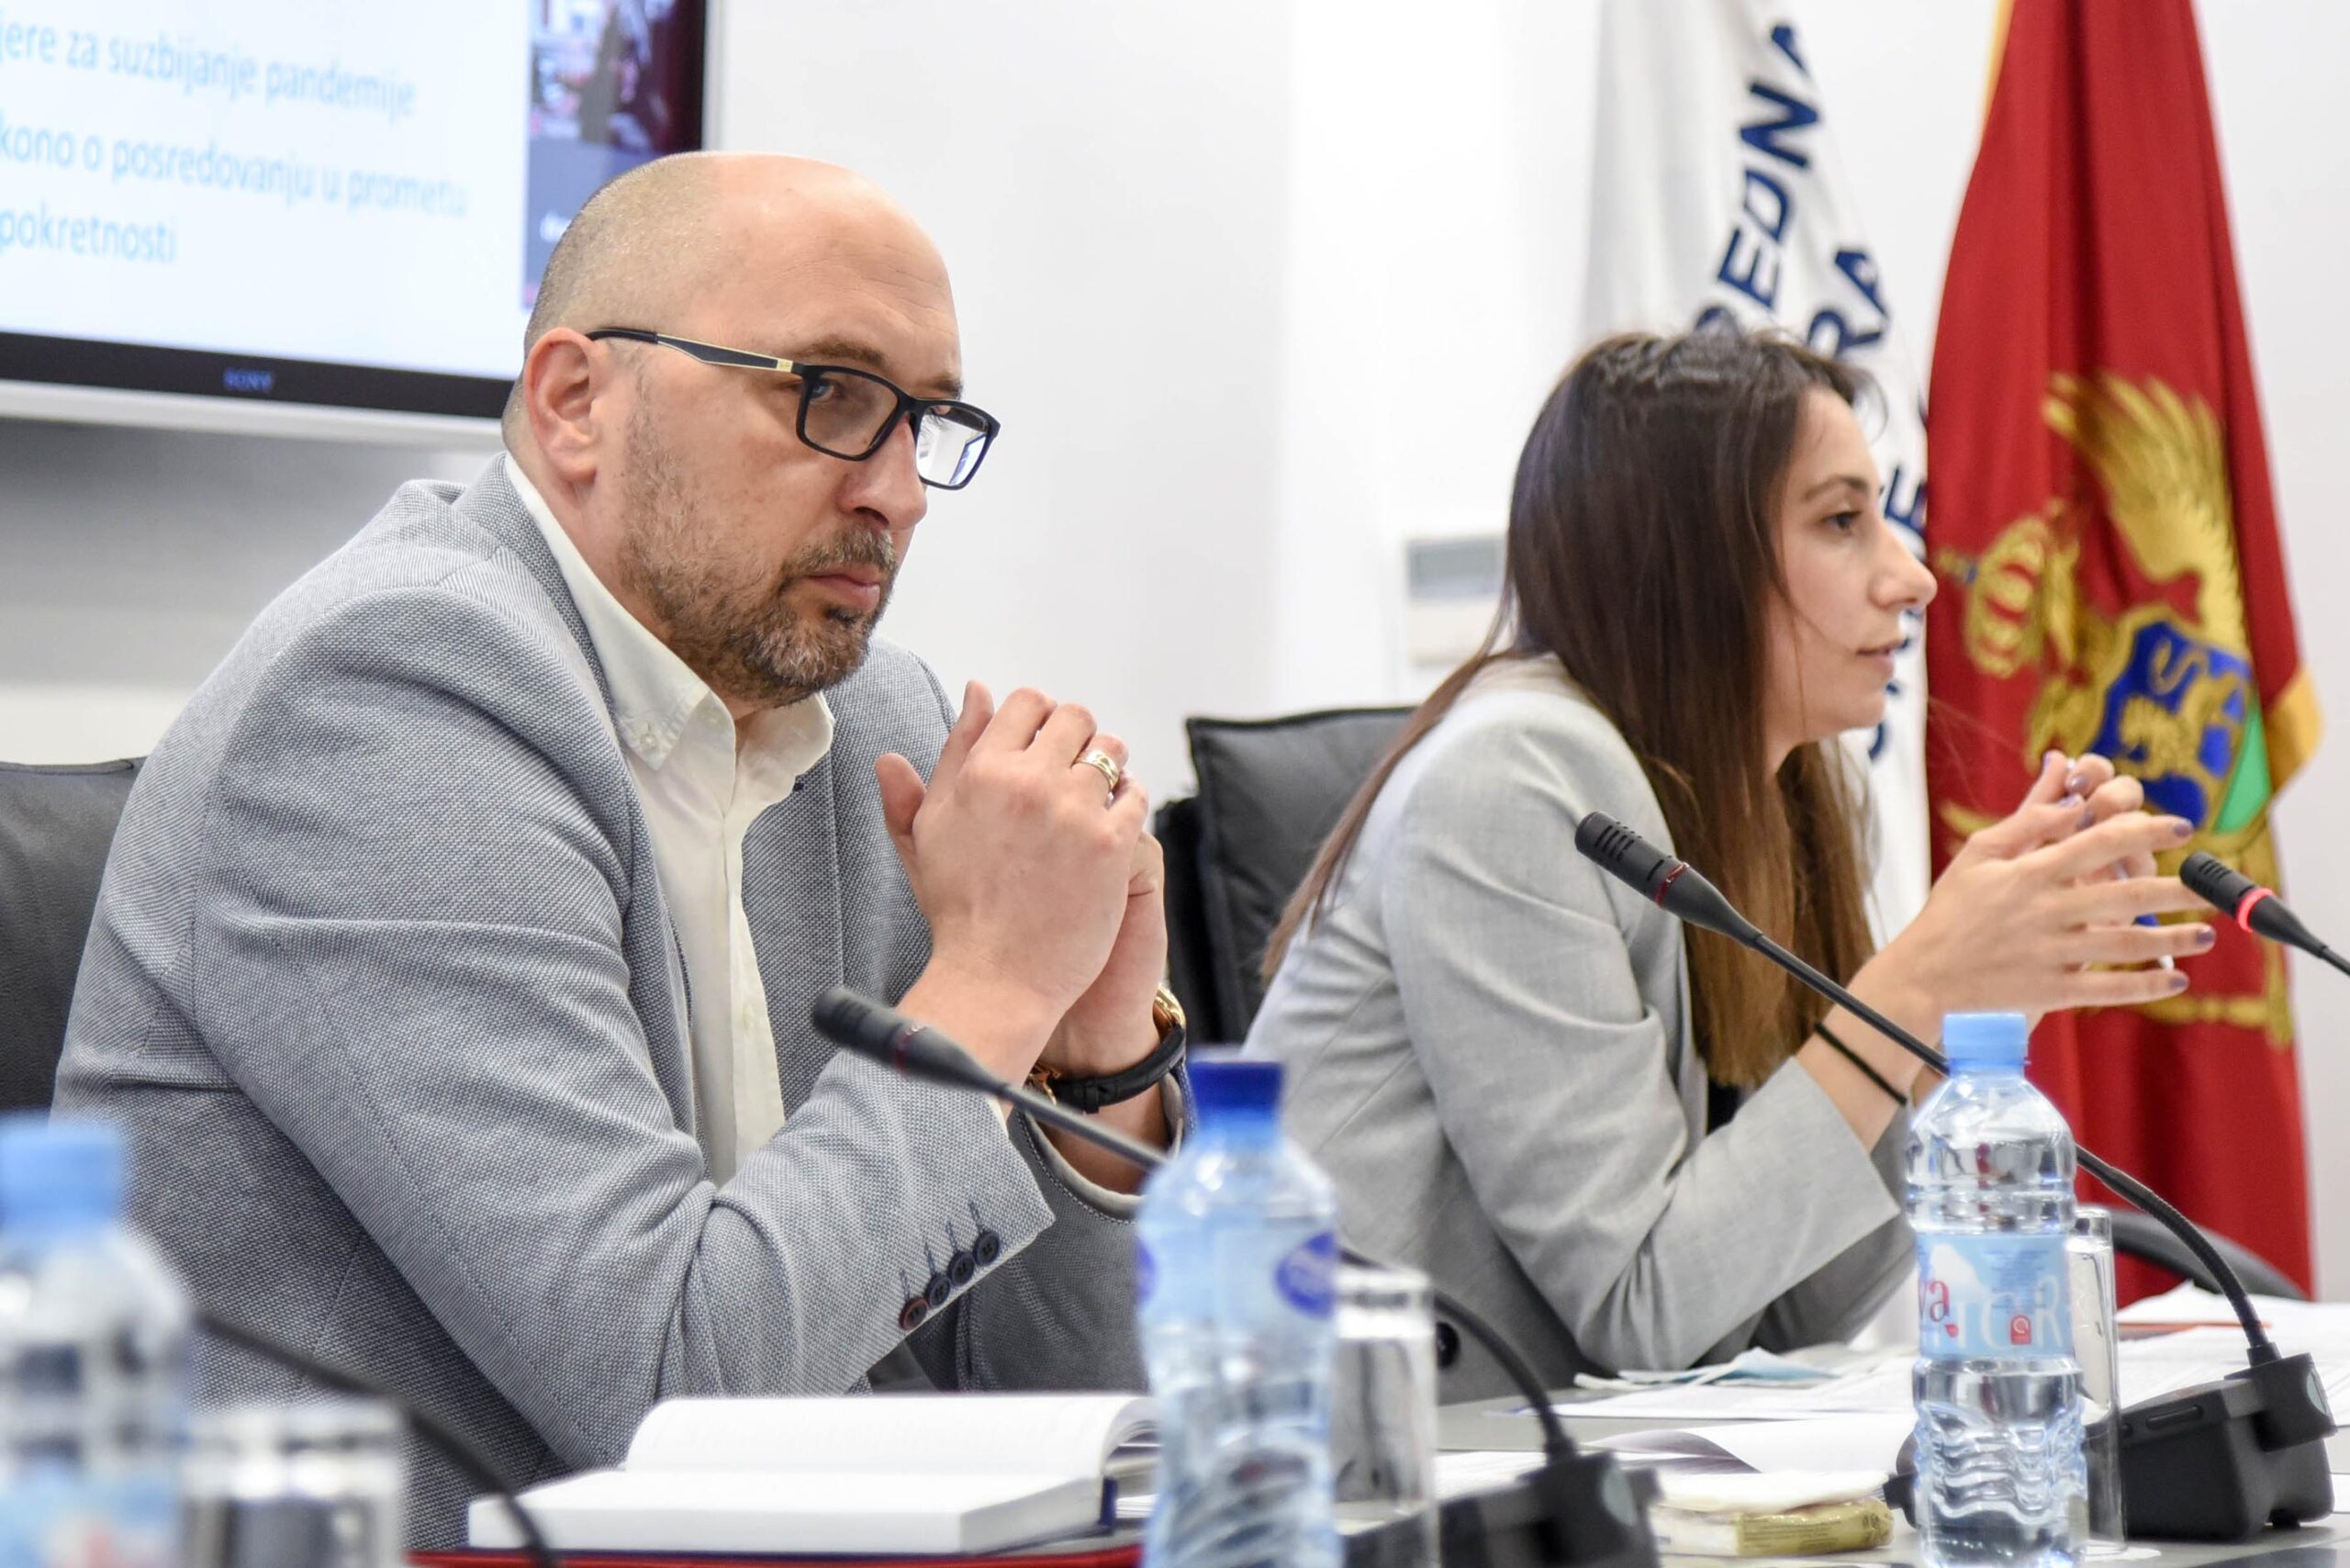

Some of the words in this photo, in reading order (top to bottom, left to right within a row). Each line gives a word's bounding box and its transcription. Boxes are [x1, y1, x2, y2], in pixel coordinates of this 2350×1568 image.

[66, 30, 100, 71] za
[107, 29, 259, 104] suzbijanje
[265, 58, 417, 123] pandemije
[84, 134, 104, 172] o
[112, 138, 314, 207] posredovanju
[321, 168, 341, 204] u
[347, 168, 467, 218] prometu
[0, 200, 178, 265] pokretnosti
